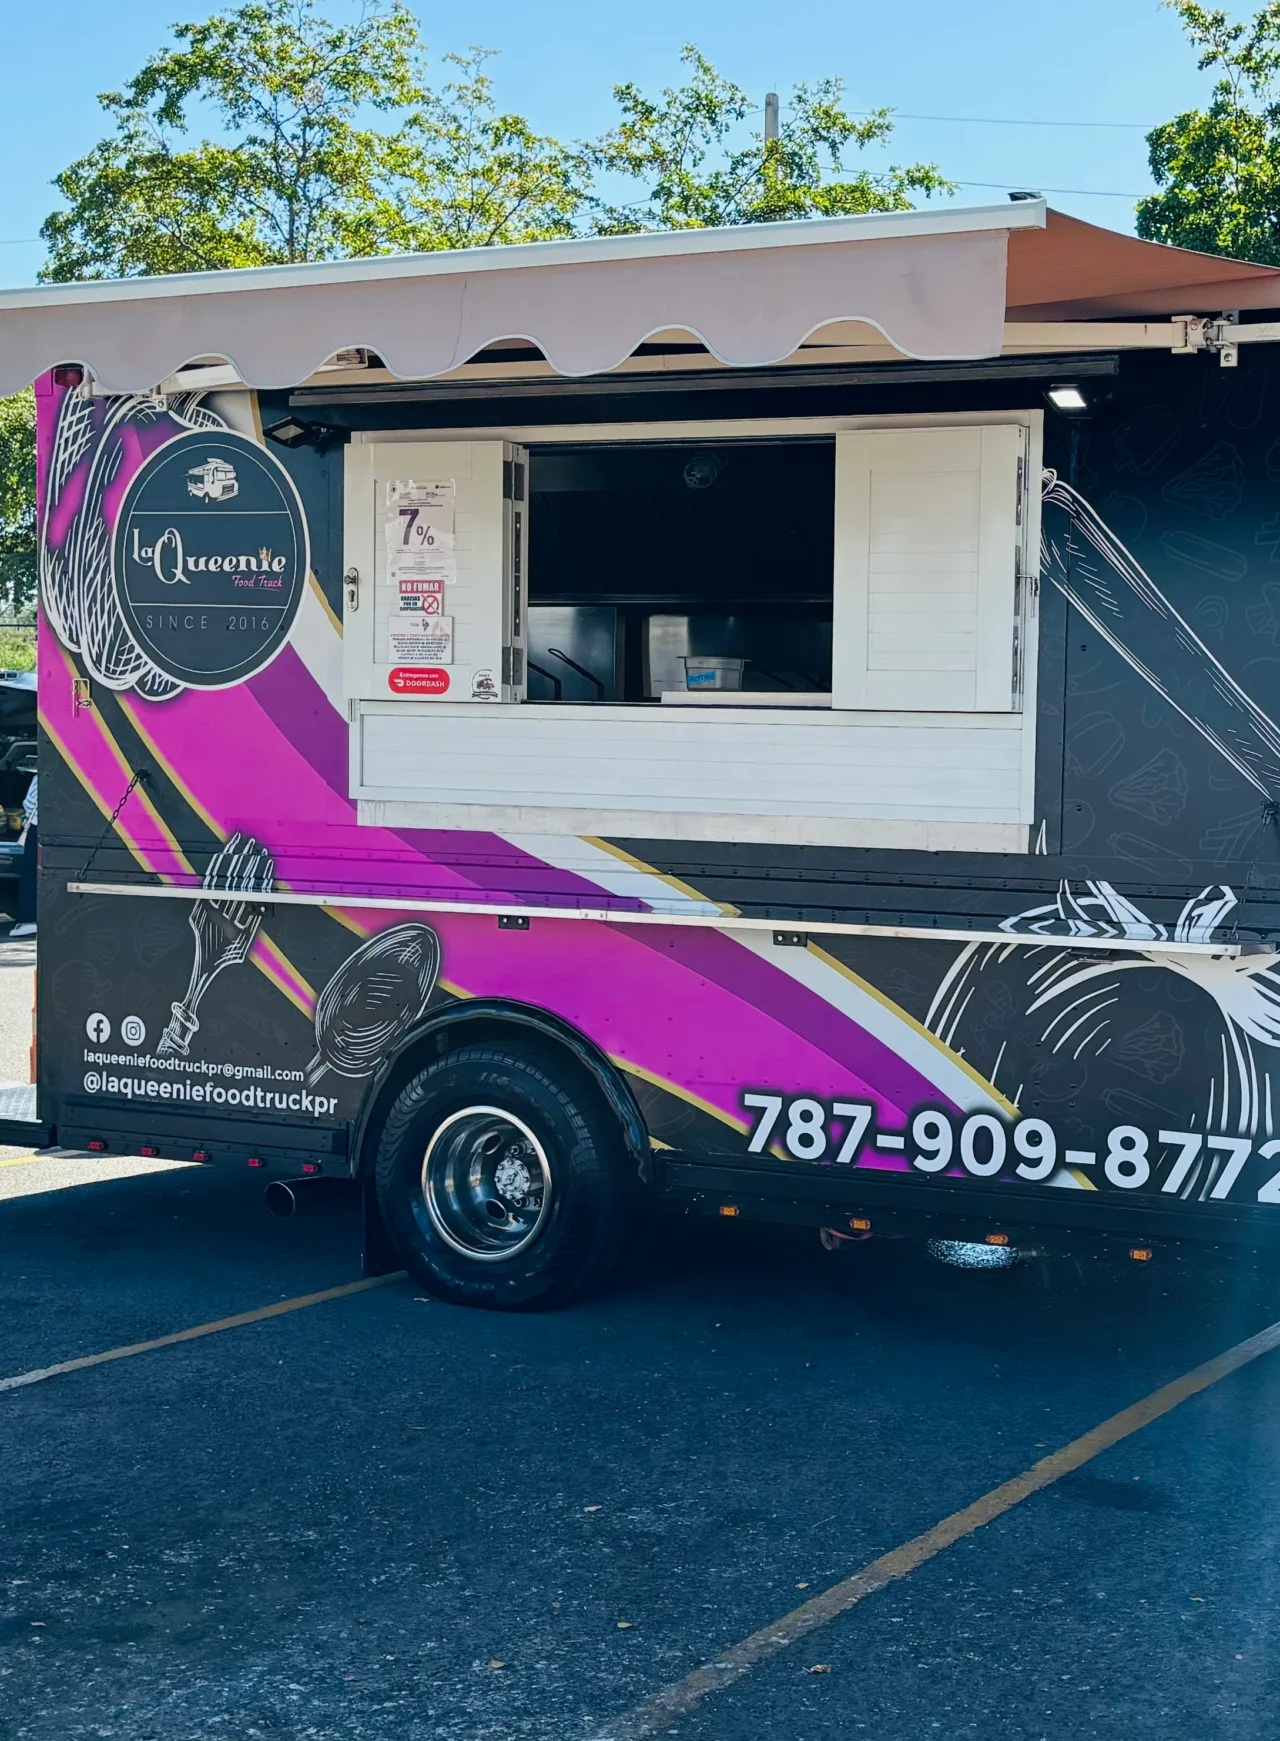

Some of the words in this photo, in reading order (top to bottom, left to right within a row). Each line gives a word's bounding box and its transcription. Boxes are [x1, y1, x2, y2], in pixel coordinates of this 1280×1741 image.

[399, 508, 434, 546] 7%
[132, 528, 153, 566] La
[154, 527, 287, 584] Queenie
[232, 575, 255, 587] Food
[258, 575, 283, 588] Truck
[401, 582, 412, 592] NO
[413, 582, 439, 592] FUMAR
[146, 615, 208, 630] SINCE
[228, 616, 269, 630] 2016
[84, 1049, 304, 1082] laqueeniefoodtruckpr@gmail.com
[83, 1071, 338, 1117] @laqueeniefoodtruckpr
